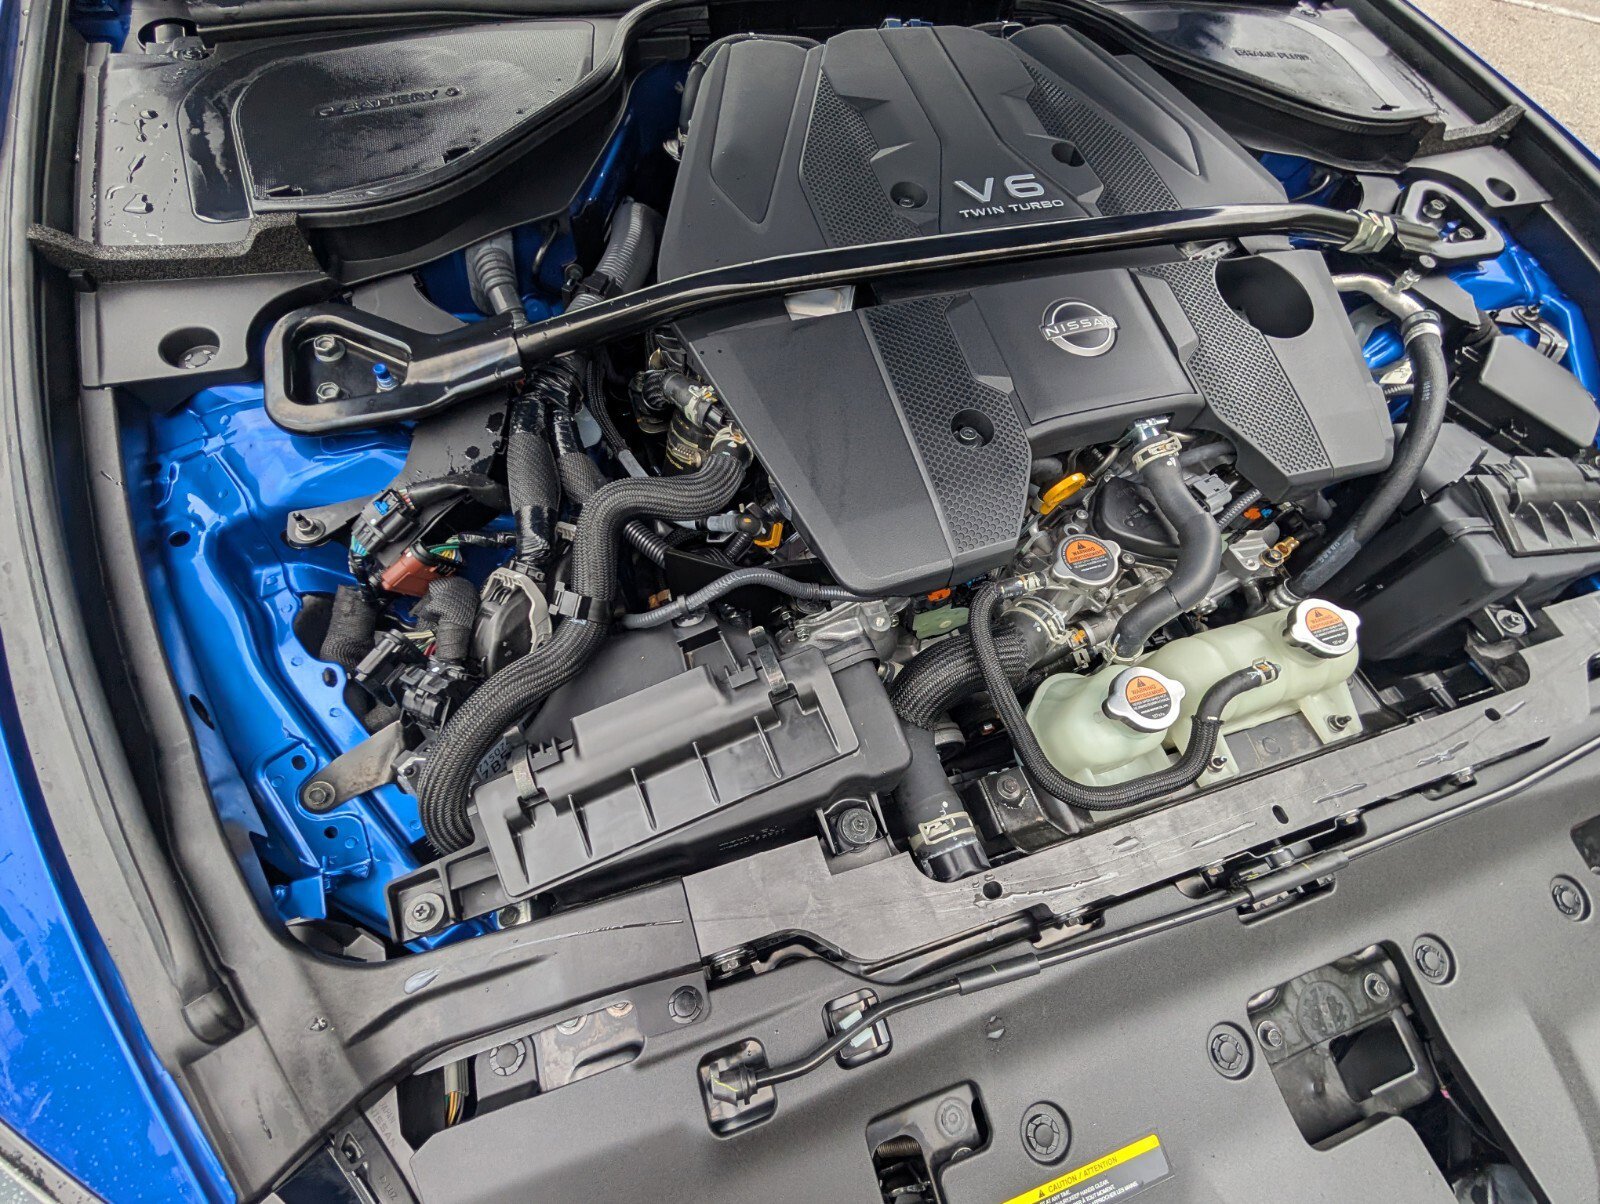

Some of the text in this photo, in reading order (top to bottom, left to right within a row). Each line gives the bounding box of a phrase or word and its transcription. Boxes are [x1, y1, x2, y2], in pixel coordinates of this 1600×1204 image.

[341, 90, 439, 113] BATTERY
[959, 199, 1065, 218] TWIN TURBO
[1045, 317, 1115, 337] NISSAN
[1048, 1174, 1077, 1193] CAUTION
[1083, 1156, 1118, 1177] ATTENTION
